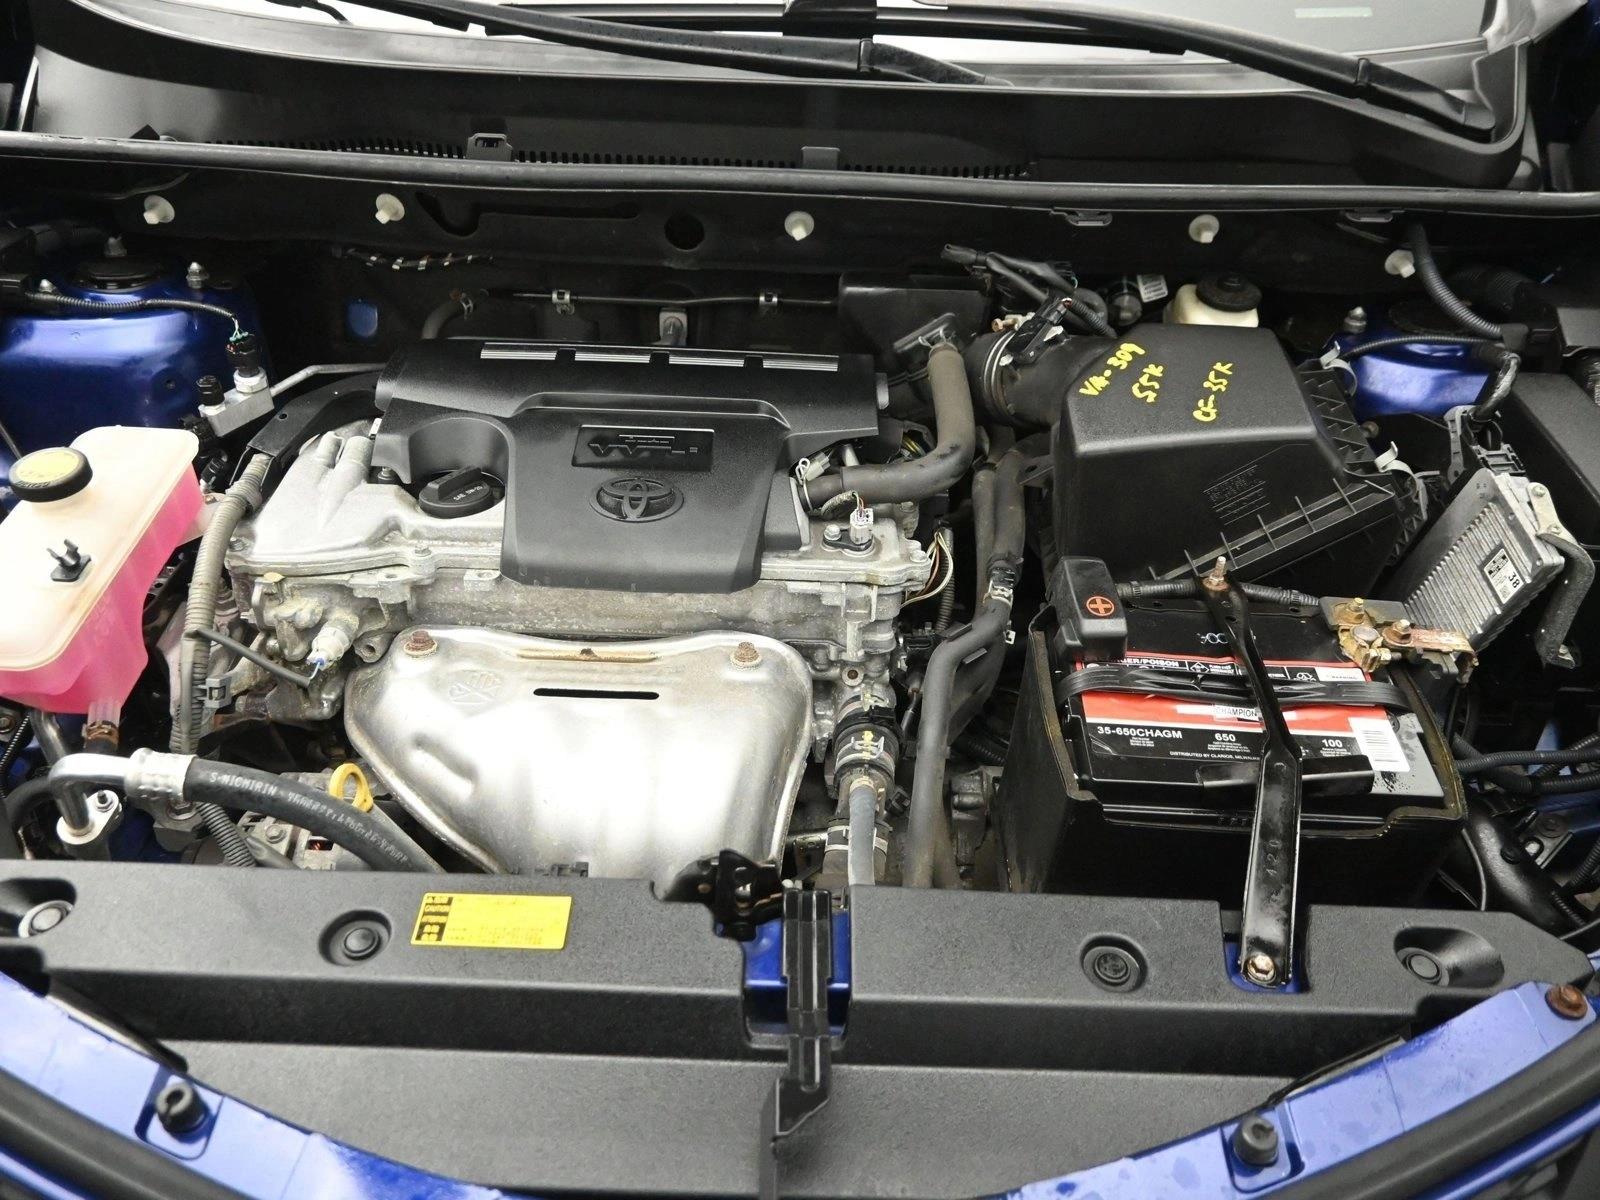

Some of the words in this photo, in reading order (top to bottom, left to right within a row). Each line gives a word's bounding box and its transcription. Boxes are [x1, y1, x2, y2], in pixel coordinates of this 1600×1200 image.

[1121, 657, 1180, 668] GER/POISON
[1096, 726, 1183, 739] 35-650CHAGM
[1214, 733, 1236, 742] 650
[1321, 738, 1343, 748] 100
